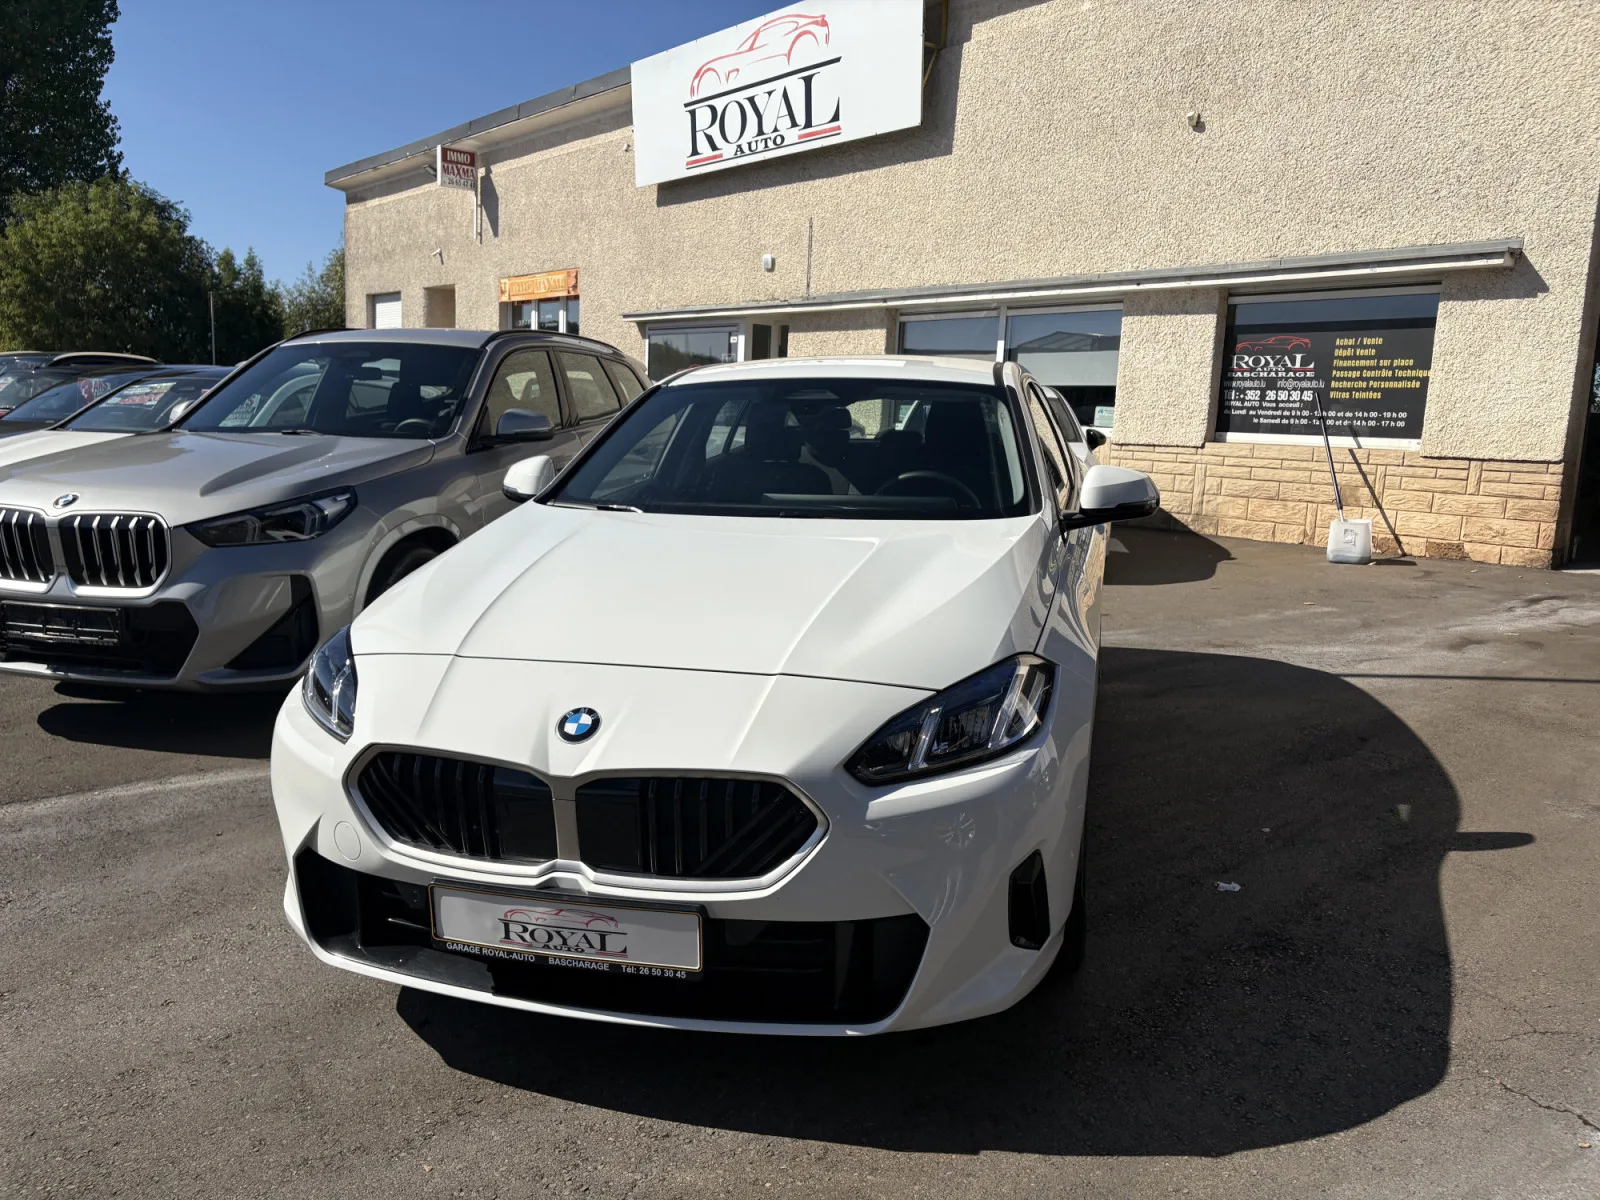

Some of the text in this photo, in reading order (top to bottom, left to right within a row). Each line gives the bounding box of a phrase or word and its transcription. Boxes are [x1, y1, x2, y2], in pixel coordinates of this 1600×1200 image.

[685, 71, 840, 158] ROYAL
[733, 134, 785, 156] AUTO
[447, 150, 470, 164] IMMO
[442, 163, 475, 180] MAXMA
[1335, 338, 1355, 346] Achat
[1363, 337, 1383, 345] Vente
[1334, 348, 1376, 357] Dépôt Vente
[1231, 353, 1315, 368] ROYAL
[1333, 359, 1377, 367] Financement
[1393, 358, 1414, 367] place
[1332, 369, 1361, 378] Passage
[1362, 368, 1393, 378] Contrôle
[1277, 379, 1325, 390] info@royalauto.lu
[1330, 380, 1421, 388] Recherche Personnalisée
[1265, 390, 1276, 401] 26
[1277, 390, 1288, 401] 50
[1289, 390, 1300, 401] 30
[1301, 390, 1313, 401] 45
[1329, 390, 1382, 399] Vitres Teintées
[502, 921, 627, 954] ROYAL
[541, 944, 585, 953] AUTO
[446, 942, 687, 978] GARAGE ROYAL-AUTO BASCHARAGE Tél: 26 50 30 45
